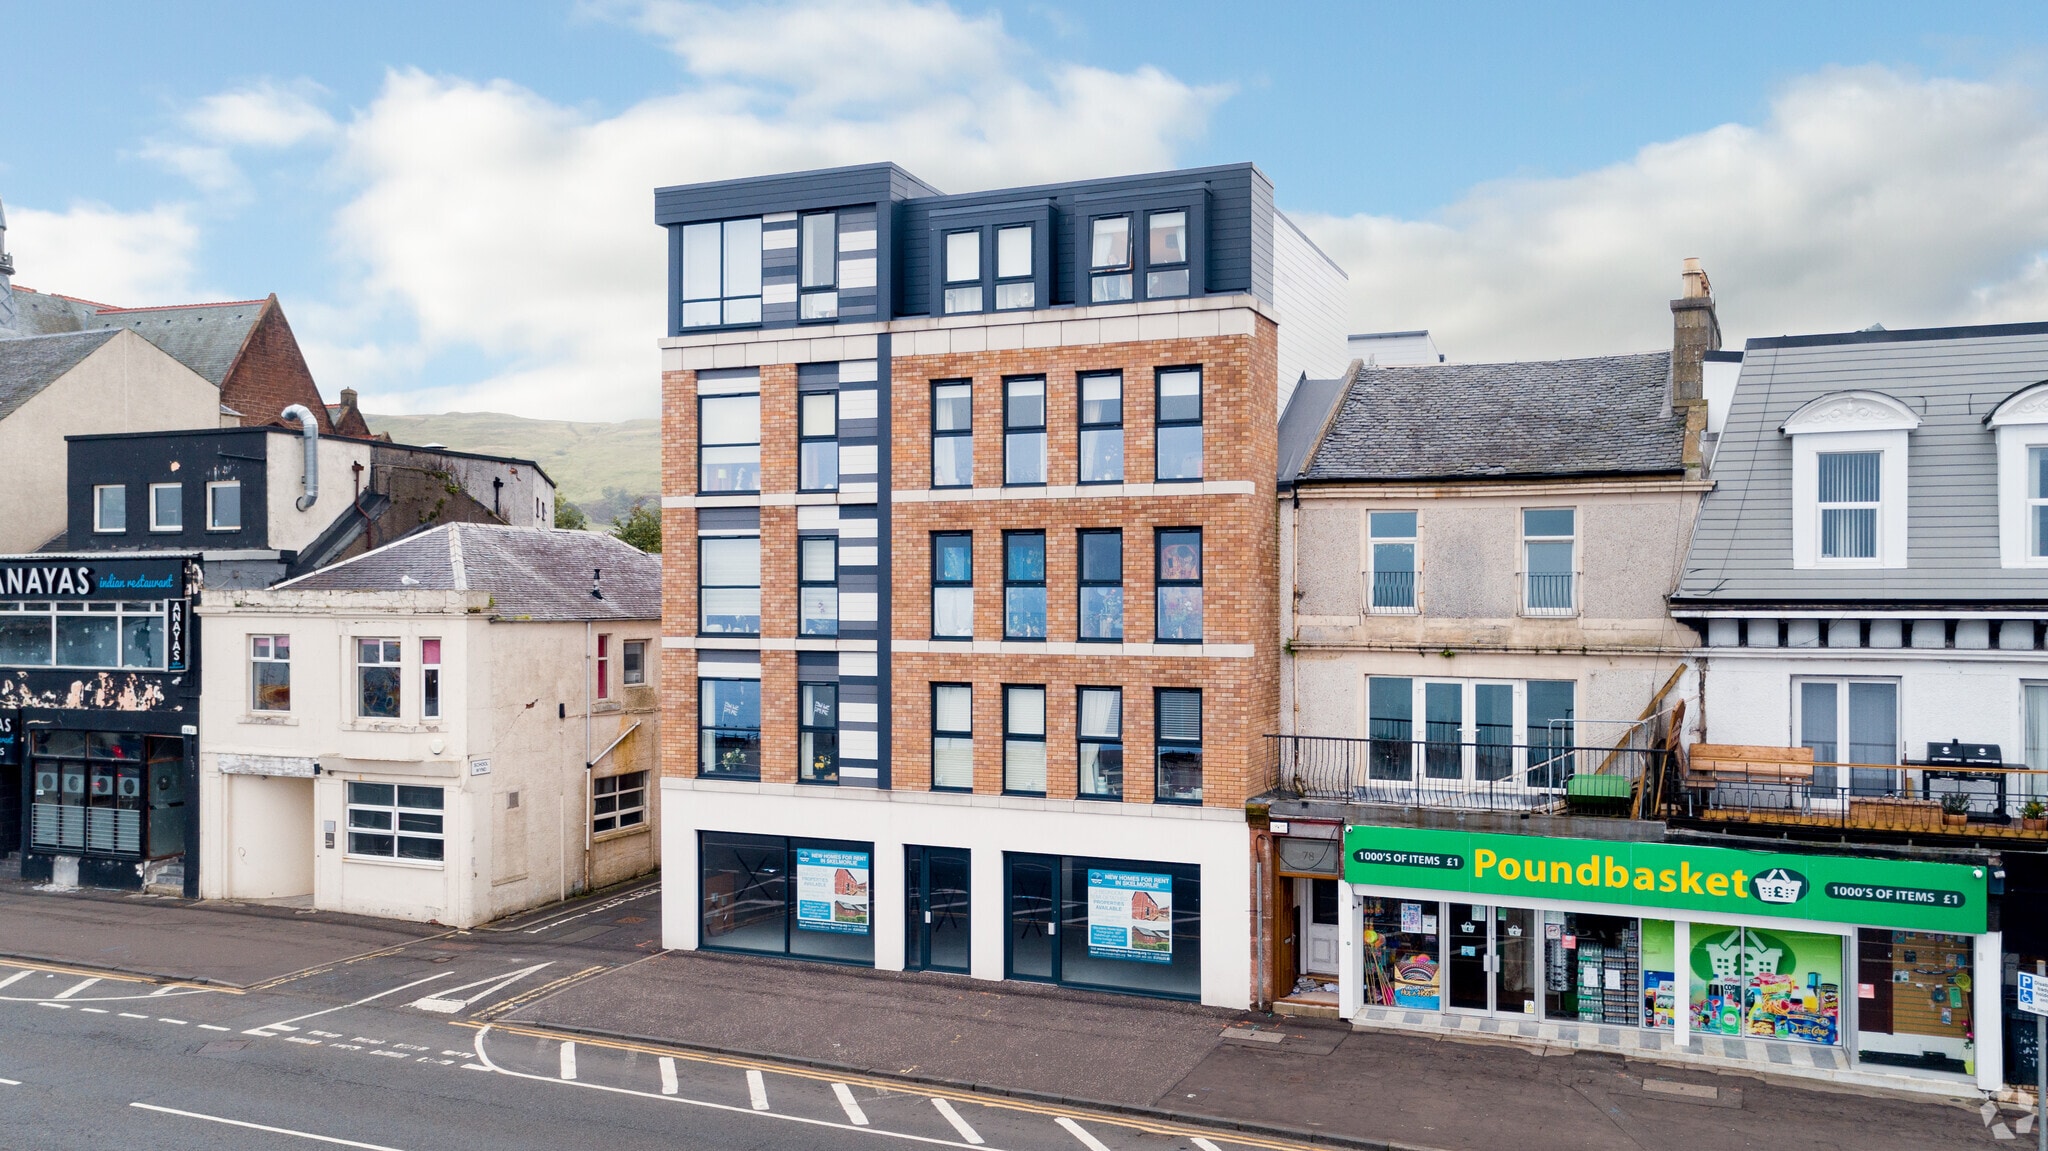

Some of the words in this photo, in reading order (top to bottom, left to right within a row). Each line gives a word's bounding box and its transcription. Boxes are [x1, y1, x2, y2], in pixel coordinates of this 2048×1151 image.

[0, 567, 90, 595] NAYAS
[100, 573, 125, 588] indian
[127, 574, 173, 588] restaurant
[172, 602, 181, 661] ANAYAS
[1302, 851, 1315, 861] 78
[1393, 854, 1407, 863] OF
[1409, 855, 1440, 865] ITEMS
[1446, 858, 1458, 867] £1
[1474, 849, 1749, 898] Poundbasket
[1875, 889, 1893, 899] OF
[1896, 890, 1935, 903] ITEMS
[1943, 894, 1958, 905] £1
[2023, 976, 2031, 987] P
